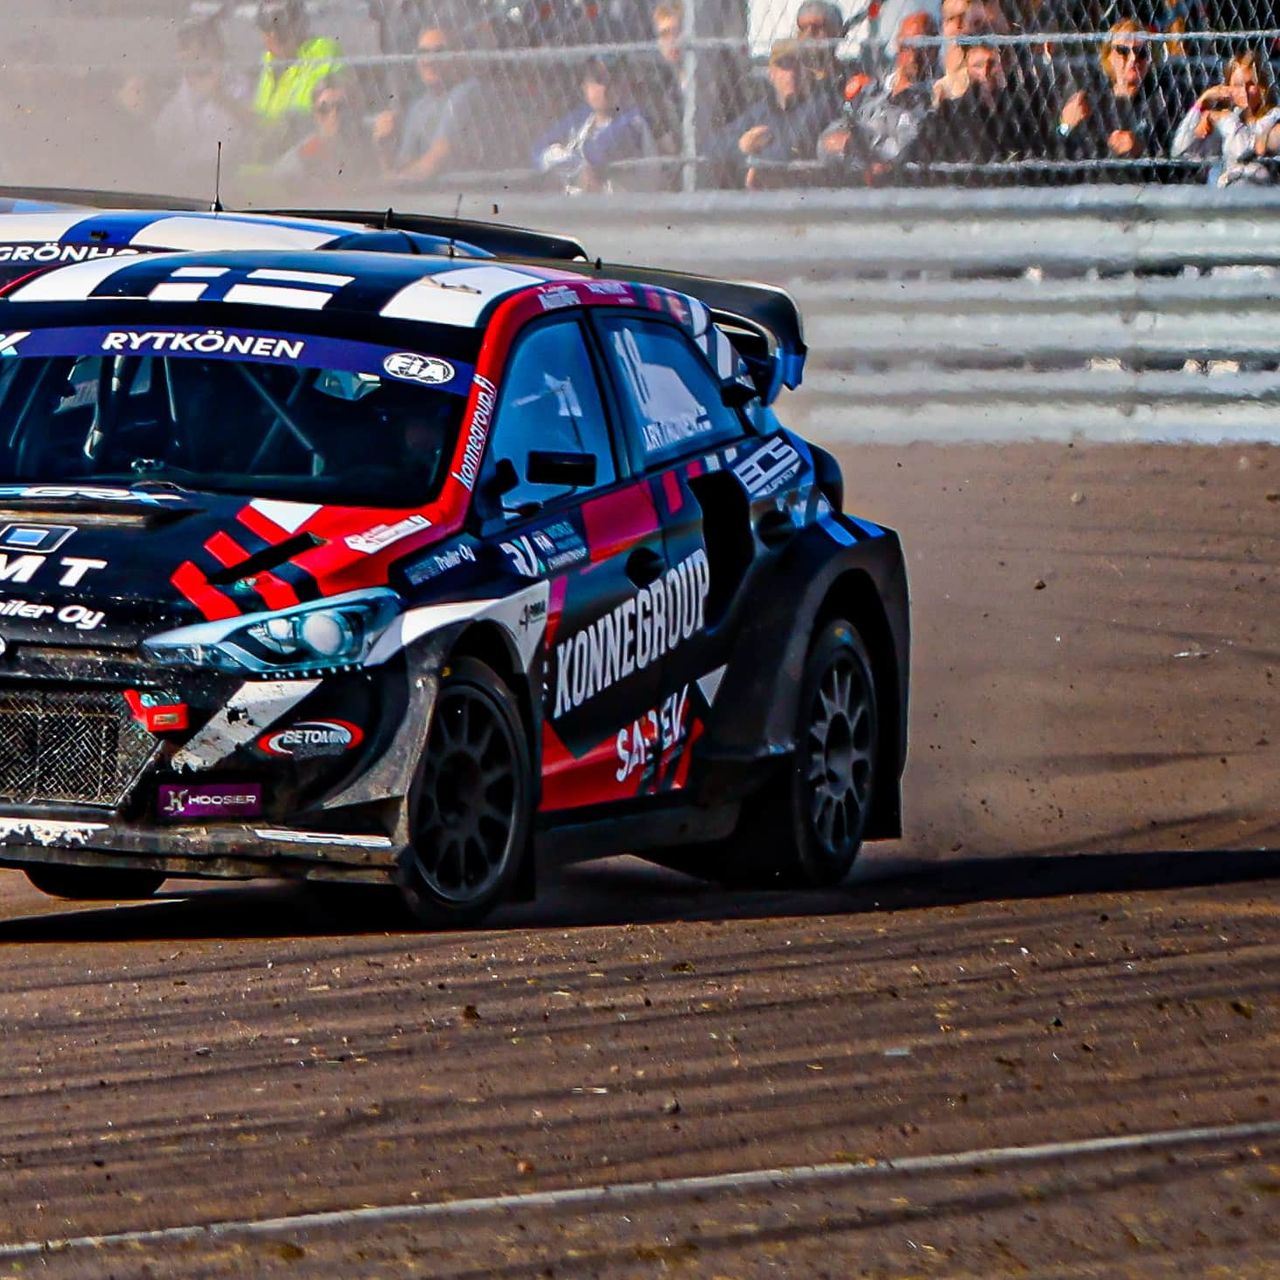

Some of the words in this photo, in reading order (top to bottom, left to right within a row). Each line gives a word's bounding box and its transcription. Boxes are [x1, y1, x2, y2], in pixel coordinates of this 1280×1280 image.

[101, 330, 304, 359] RYTKÖNEN
[387, 355, 445, 381] FIA
[57, 605, 106, 629] Oy
[553, 548, 710, 718] KONNEGROUP
[188, 793, 257, 806] HOOSIER
